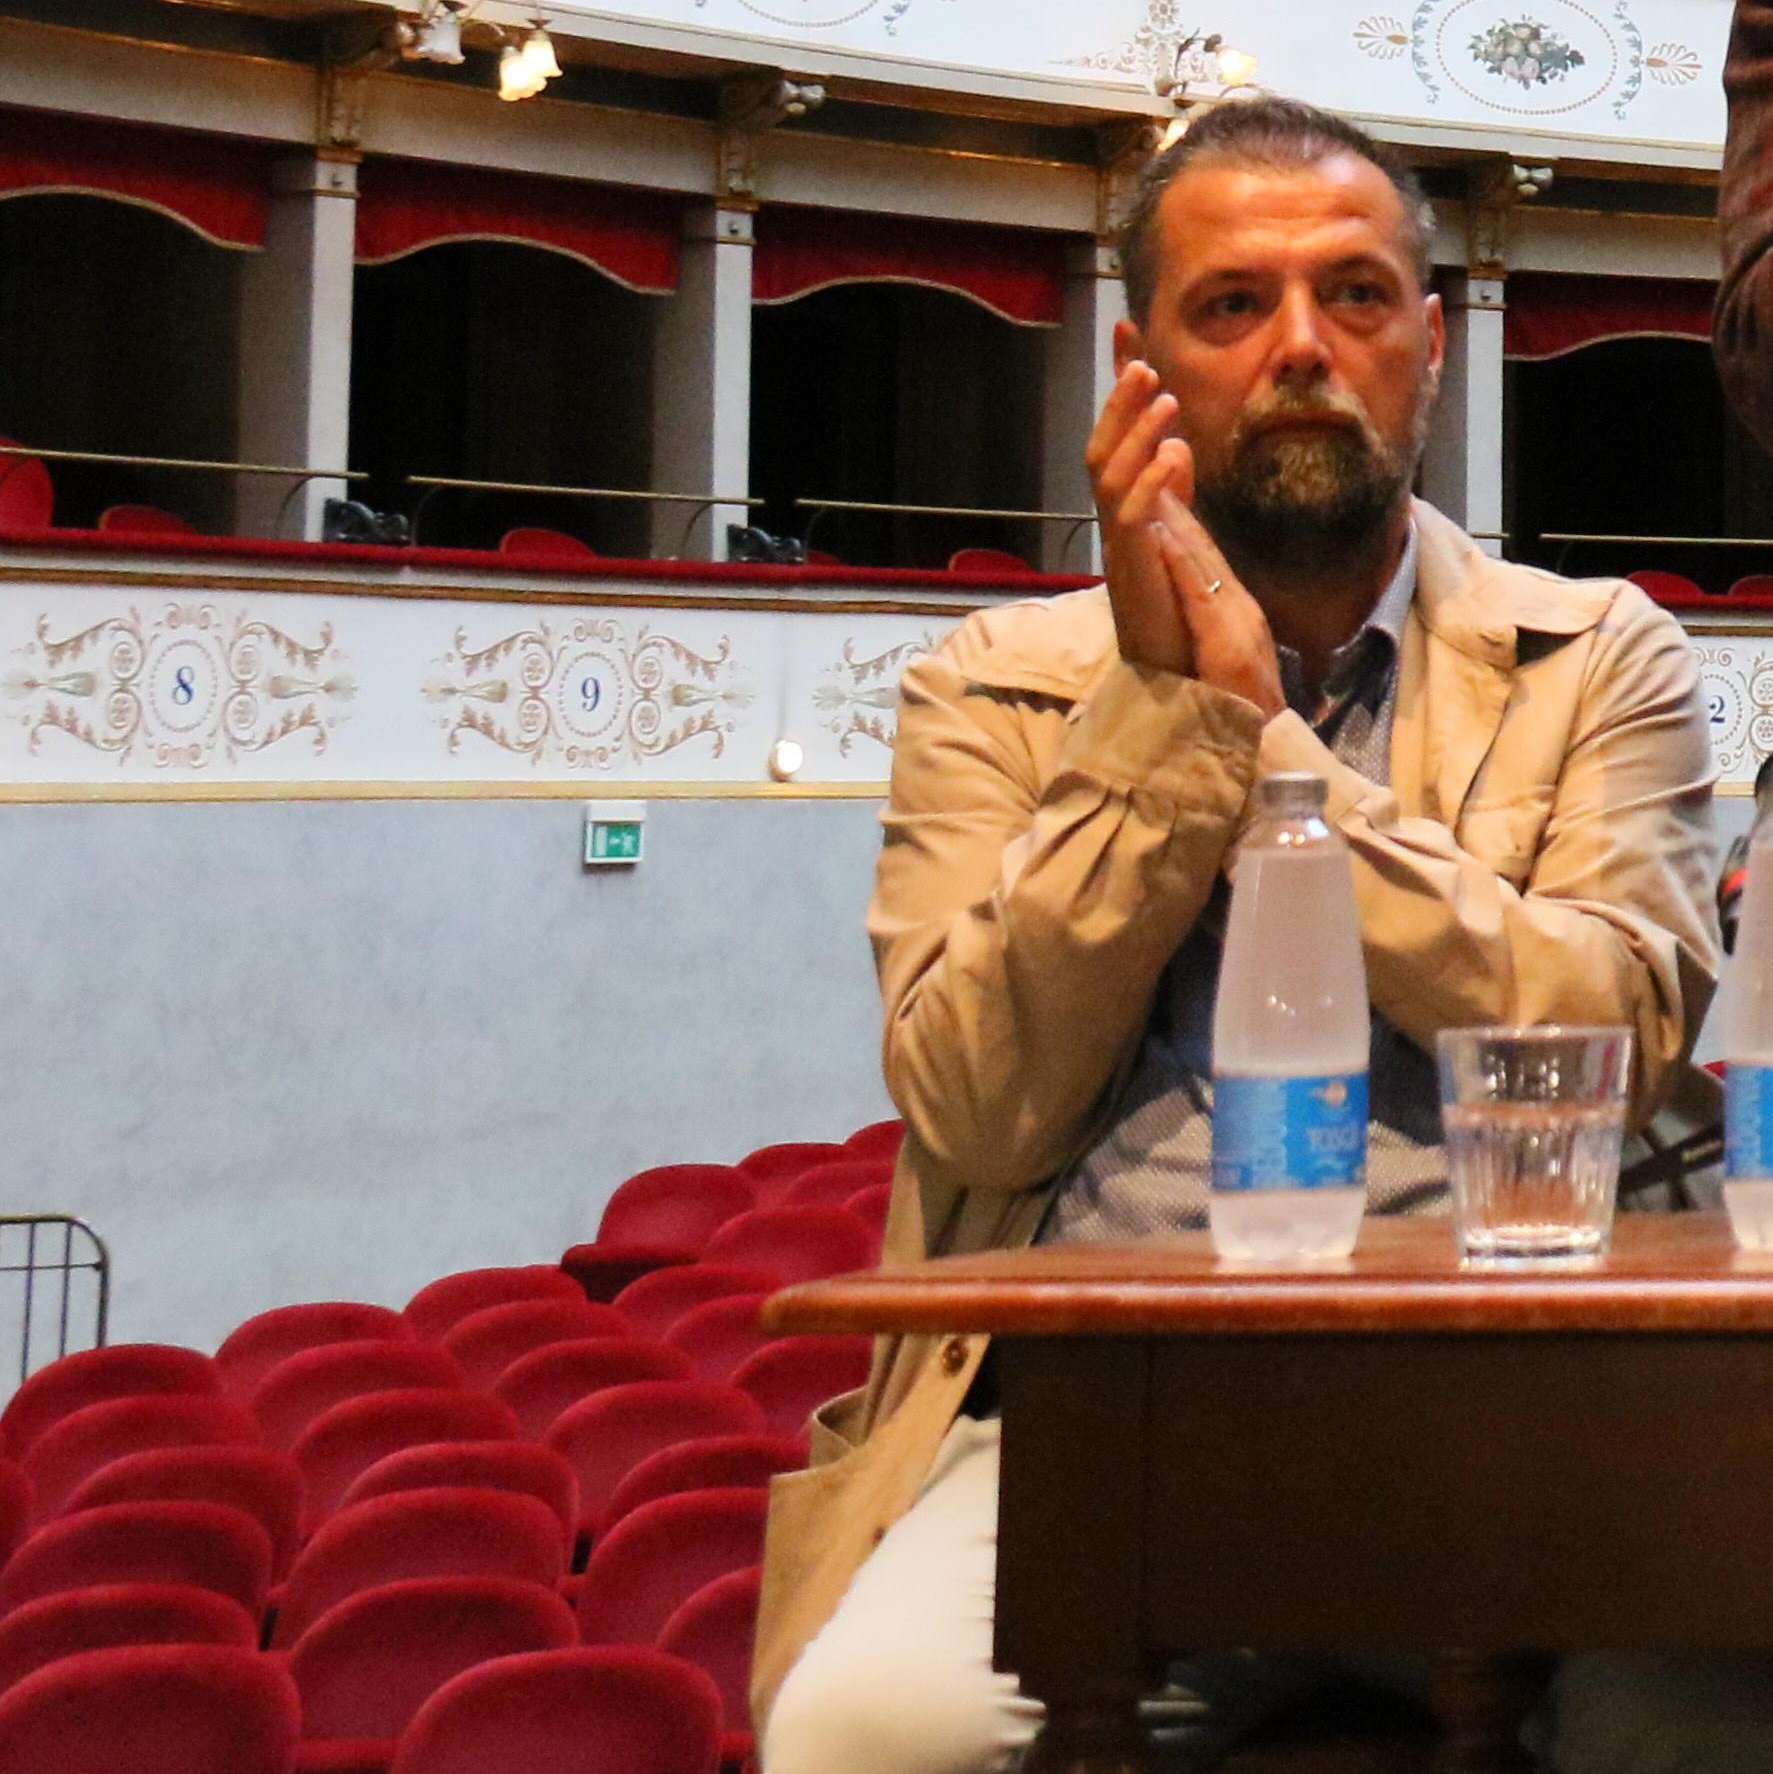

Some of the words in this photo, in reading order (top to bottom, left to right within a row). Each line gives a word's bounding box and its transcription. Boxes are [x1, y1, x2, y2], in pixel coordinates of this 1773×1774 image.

[172, 665, 194, 706] 8
[581, 676, 600, 712] 9
[1708, 695, 1726, 723] 2
